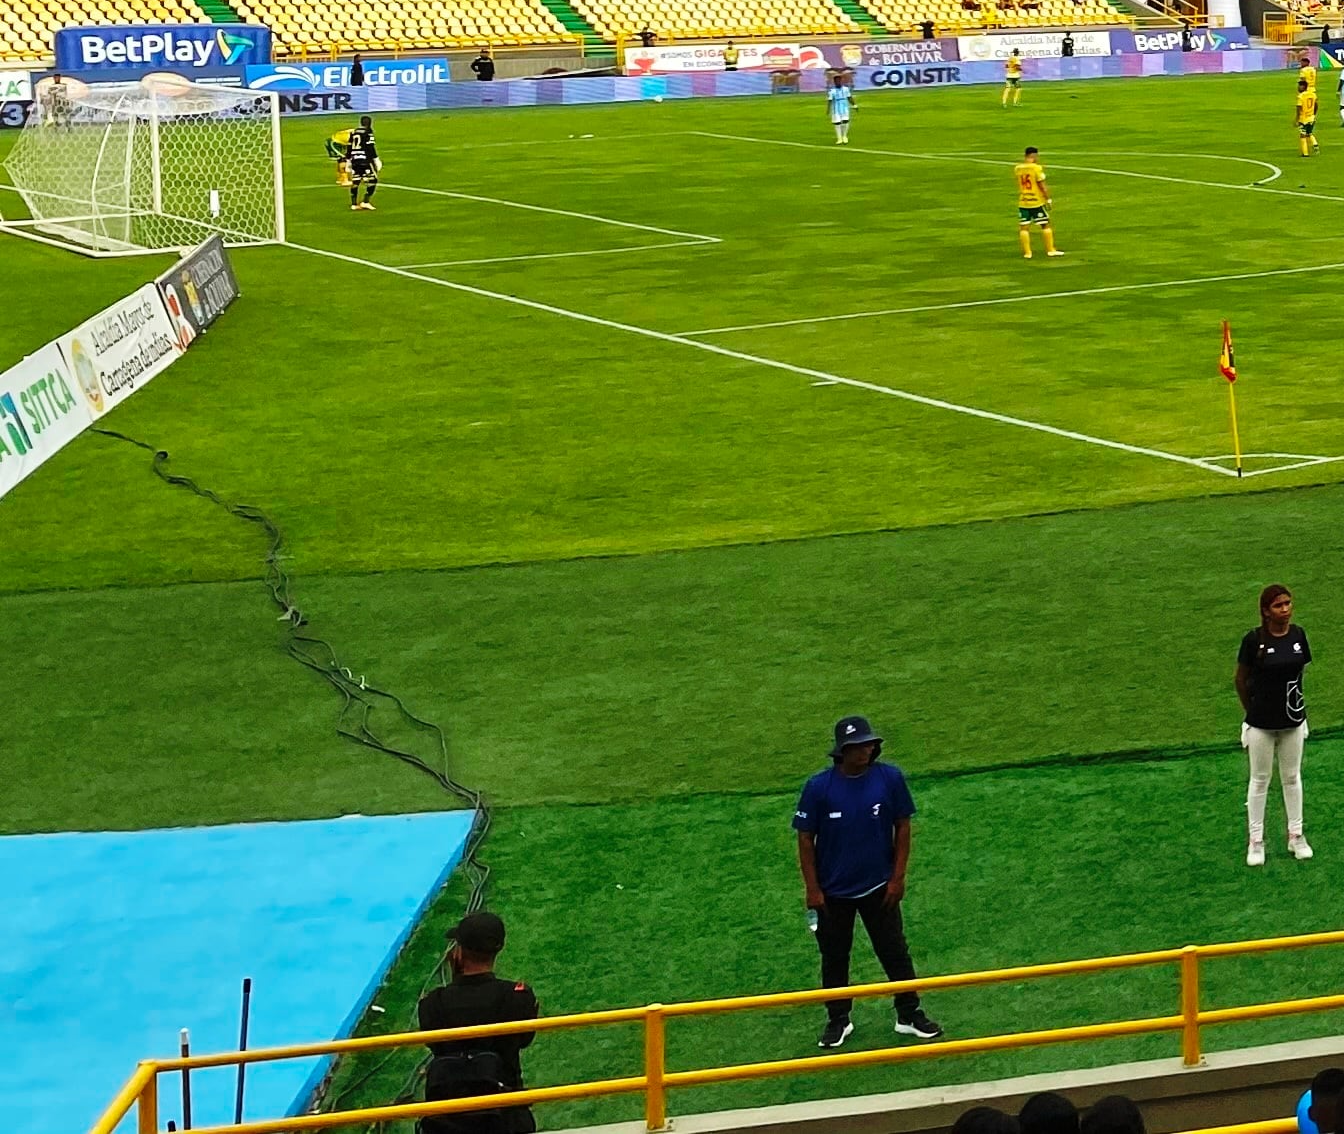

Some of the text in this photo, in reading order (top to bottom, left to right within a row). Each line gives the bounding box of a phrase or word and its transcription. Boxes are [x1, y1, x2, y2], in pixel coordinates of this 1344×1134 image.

[81, 34, 214, 65] BetPlay
[323, 63, 448, 88] Elctrolit
[870, 67, 961, 86] CONSTR
[19, 369, 77, 434] SITTCA
